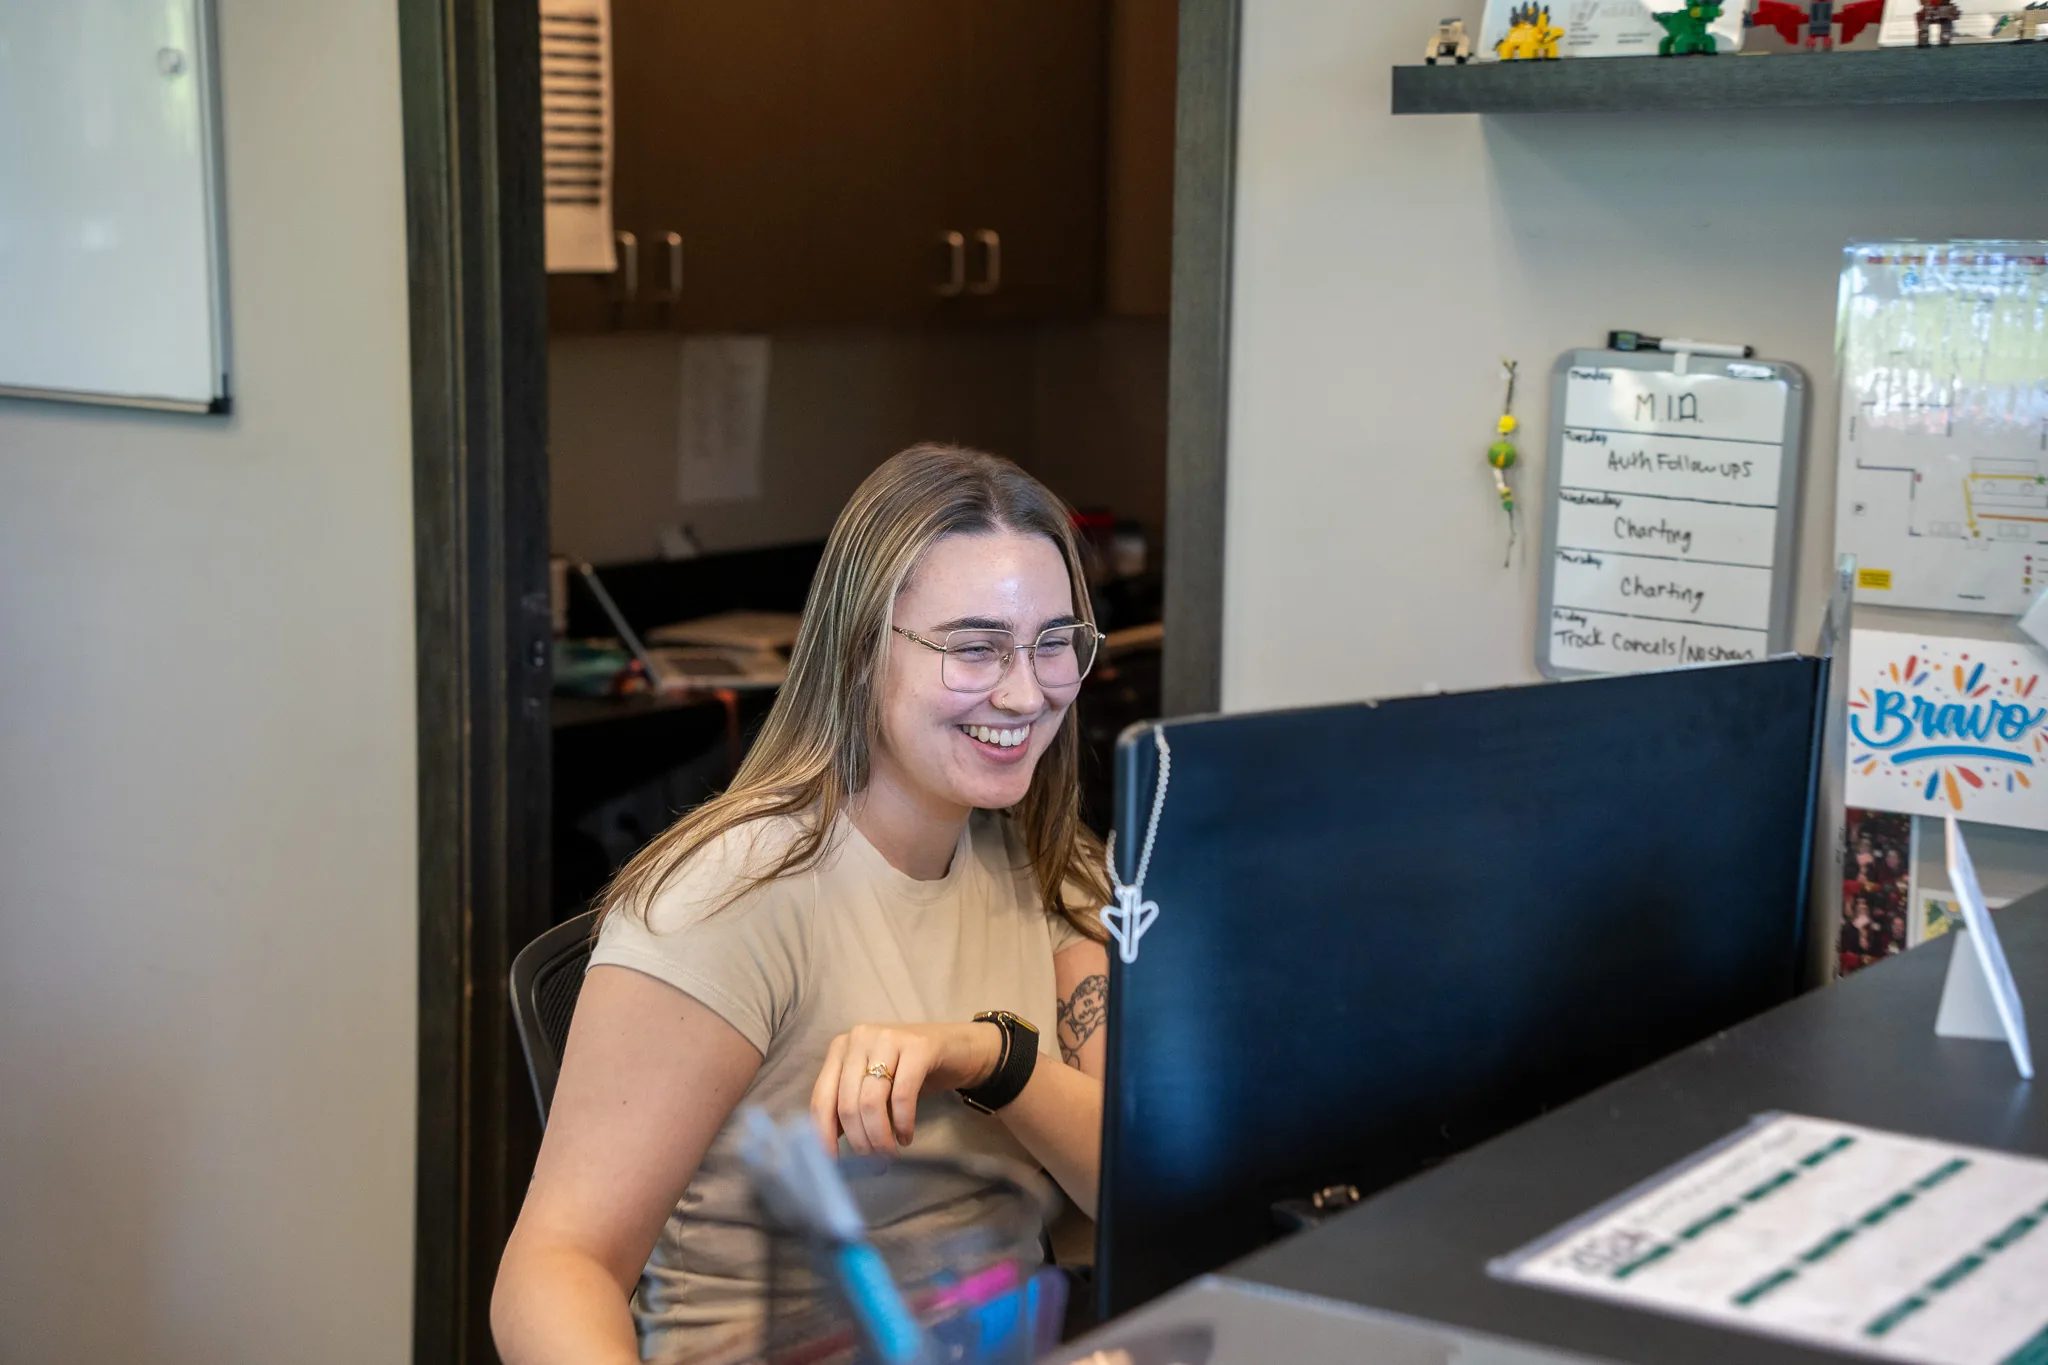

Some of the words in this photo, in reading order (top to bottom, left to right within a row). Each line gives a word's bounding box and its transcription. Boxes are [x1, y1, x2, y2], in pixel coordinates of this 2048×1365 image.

[1608, 450, 1653, 472] Auth
[1614, 516, 1692, 553] Charting
[1620, 575, 1704, 614] Charting
[1553, 626, 1605, 649] Track
[1850, 688, 2047, 749] Bravo
